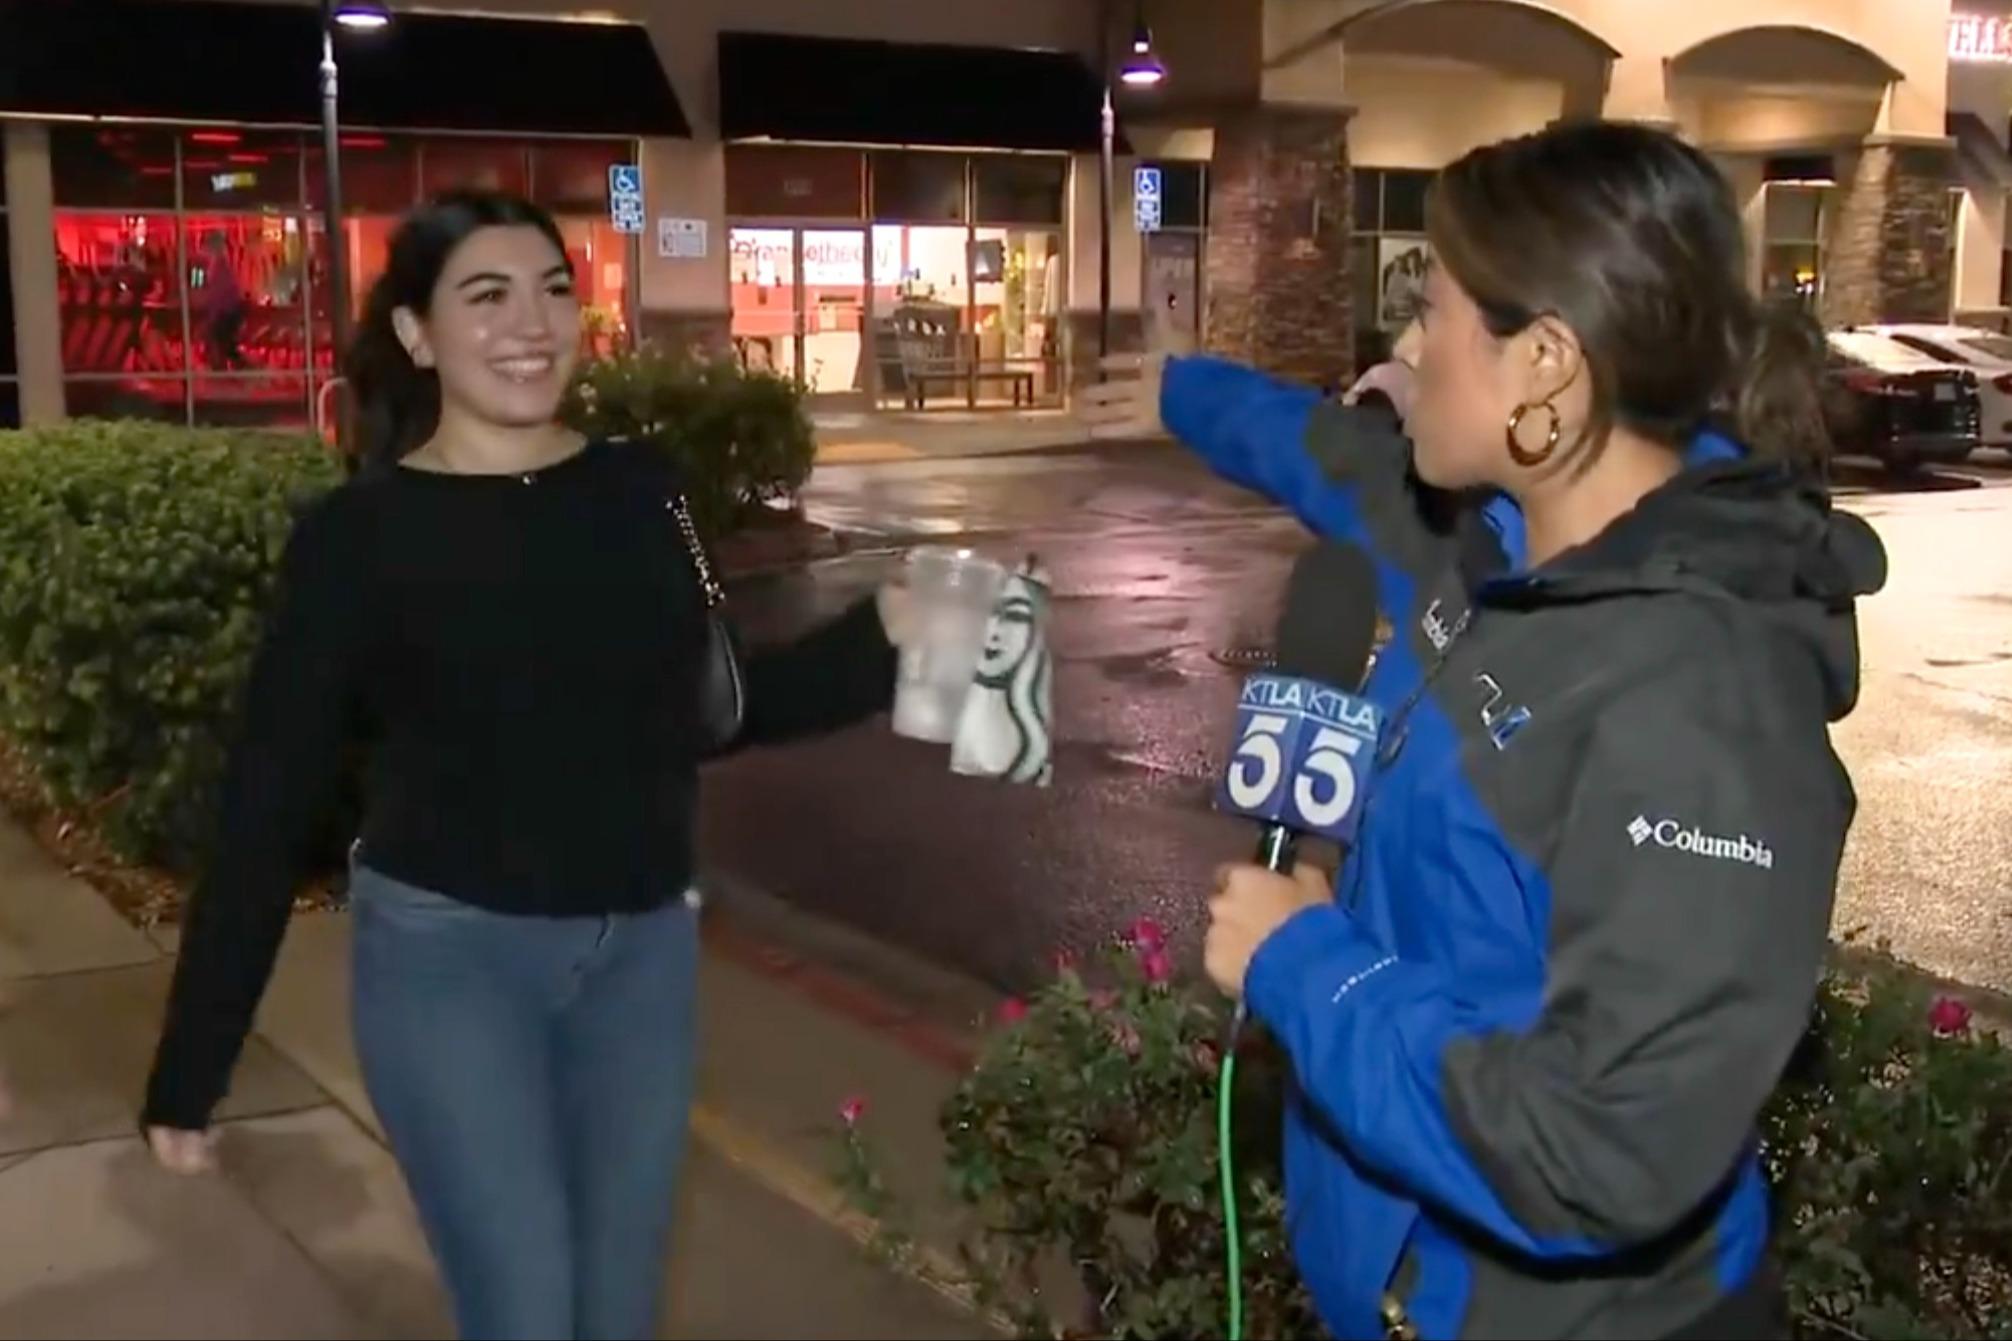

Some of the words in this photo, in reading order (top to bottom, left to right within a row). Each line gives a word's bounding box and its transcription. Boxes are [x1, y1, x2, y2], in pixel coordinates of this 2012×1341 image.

[1242, 678, 1300, 707] KTLA
[1307, 686, 1376, 732] KTLA
[1228, 714, 1288, 809] 5
[1294, 727, 1361, 827] 5
[1653, 818, 1773, 869] Columbia
